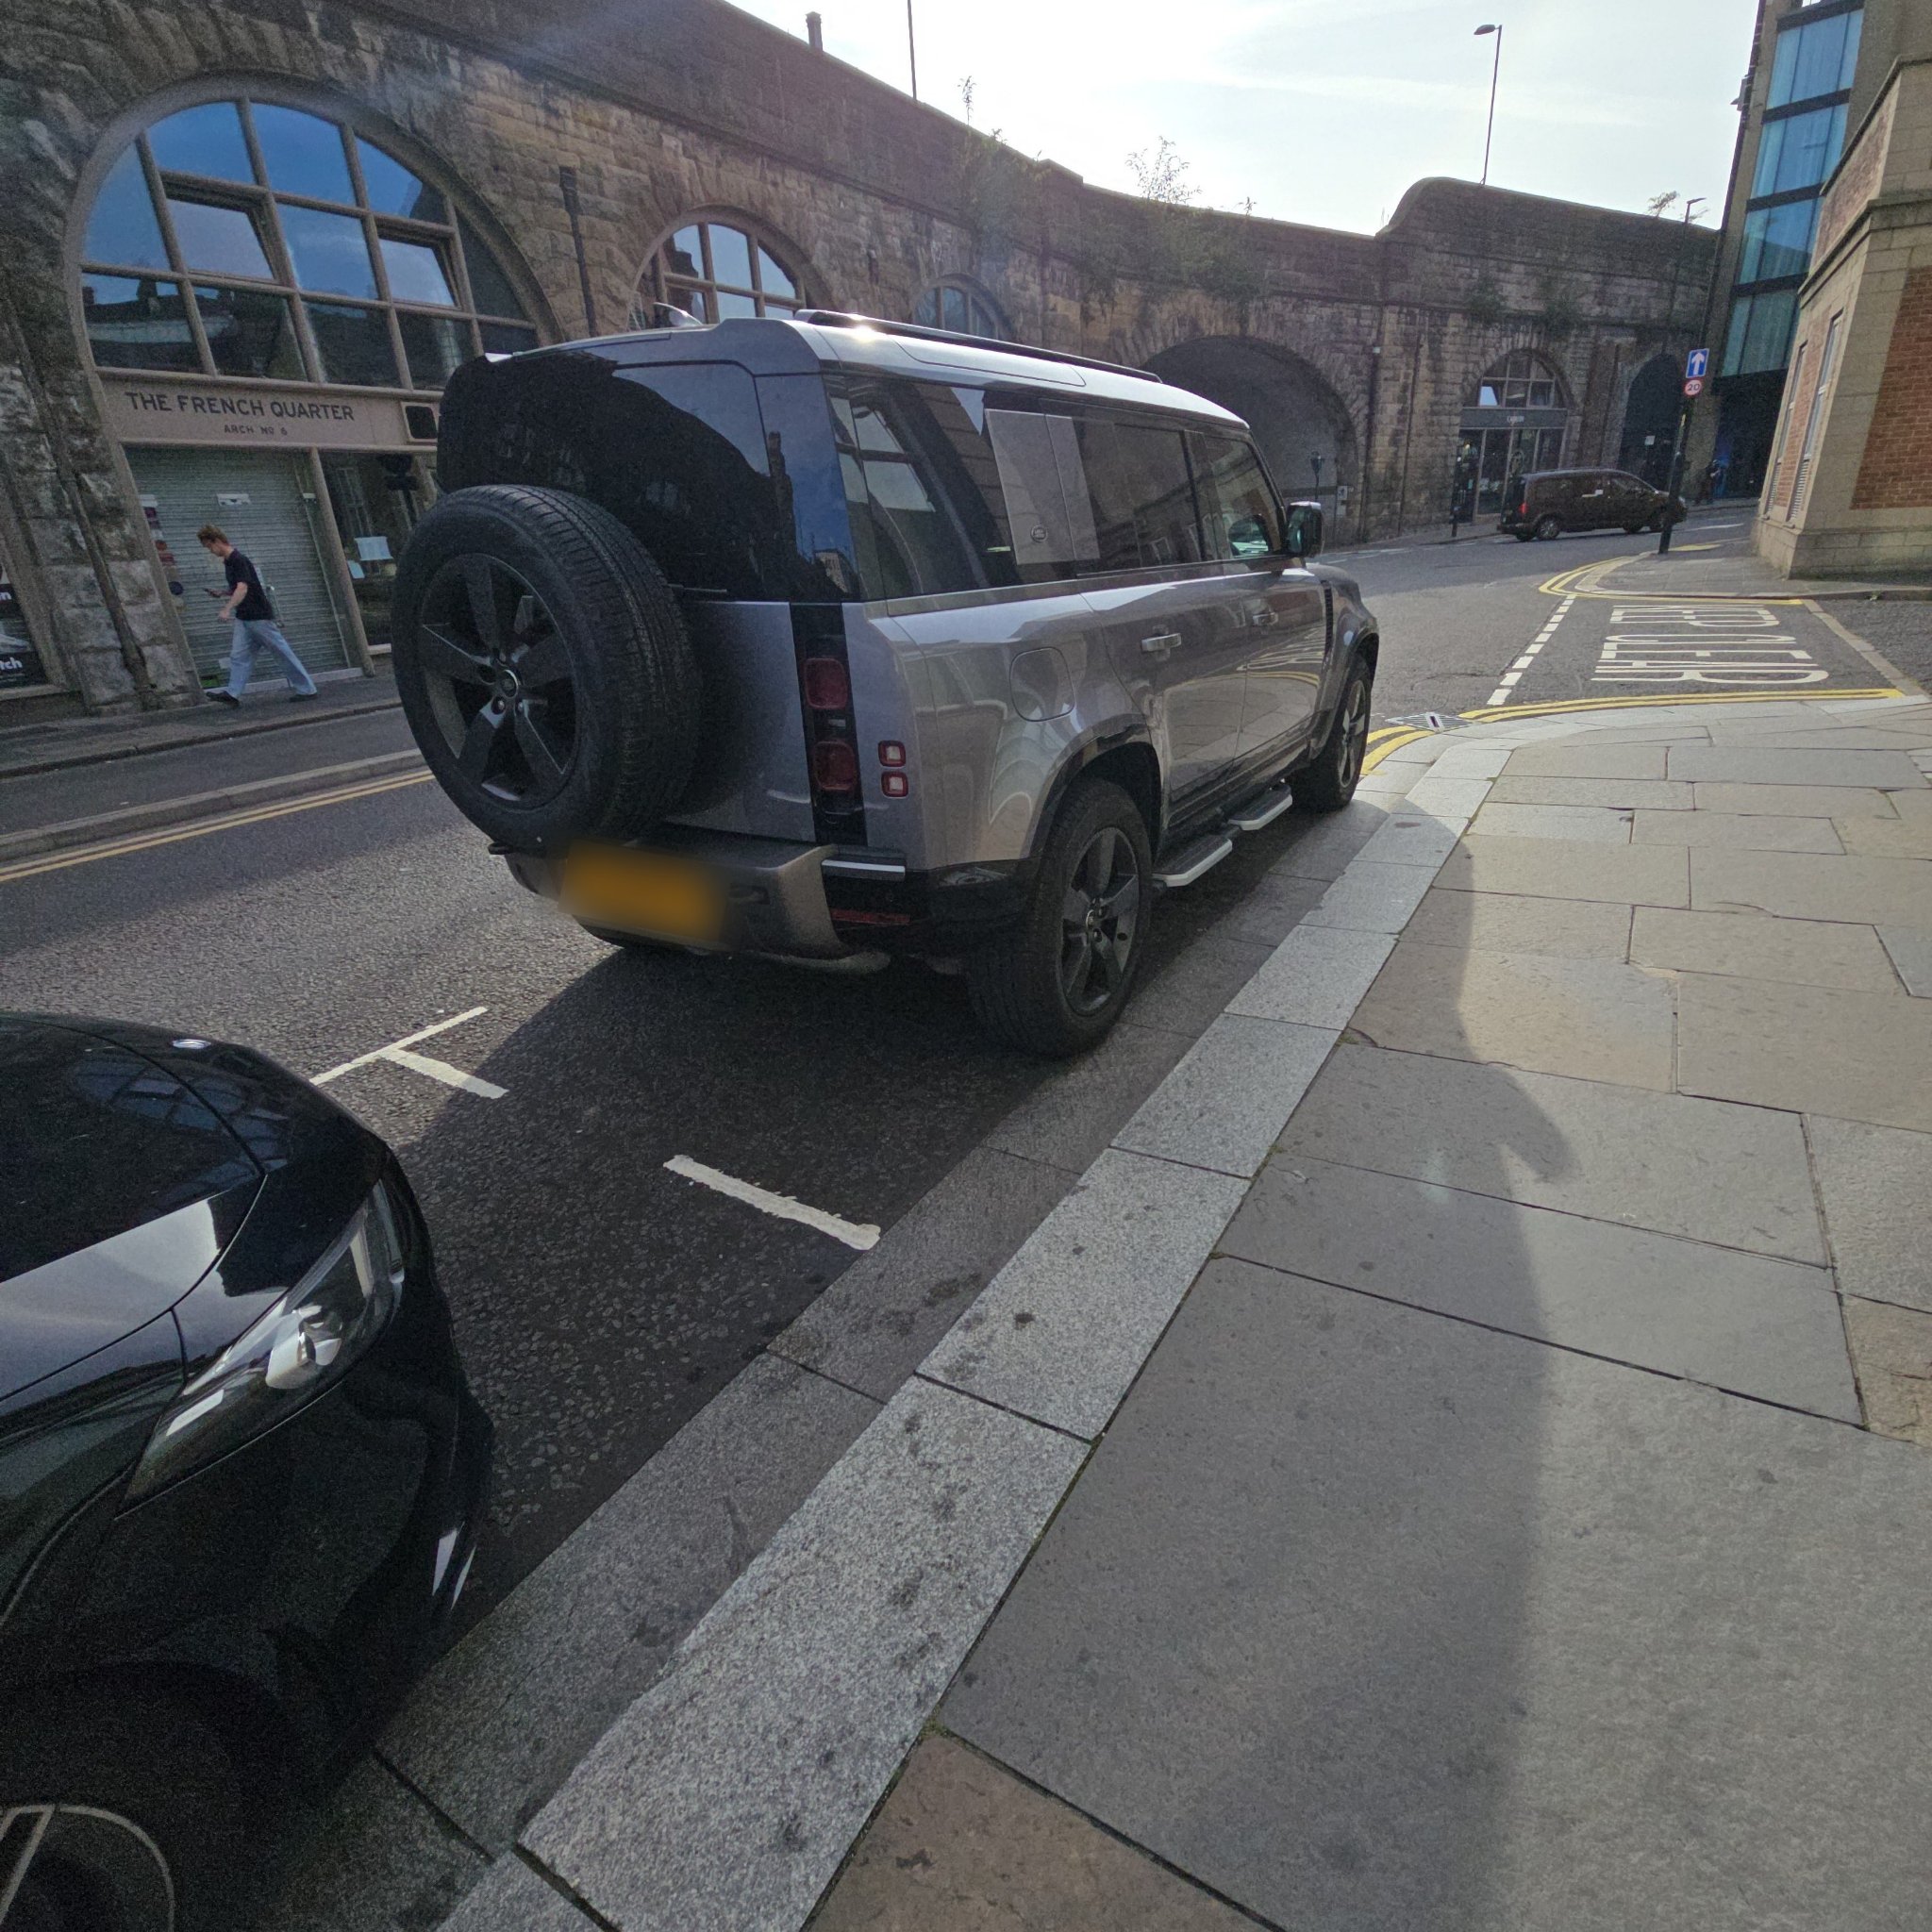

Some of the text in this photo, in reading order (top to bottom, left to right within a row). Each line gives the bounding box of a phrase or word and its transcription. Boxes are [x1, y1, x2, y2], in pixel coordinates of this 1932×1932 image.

[125, 391, 355, 422] THE FRENCH QUARTER
[224, 424, 255, 435] ARCH
[1591, 605, 1829, 684] KEEP CLEAR
